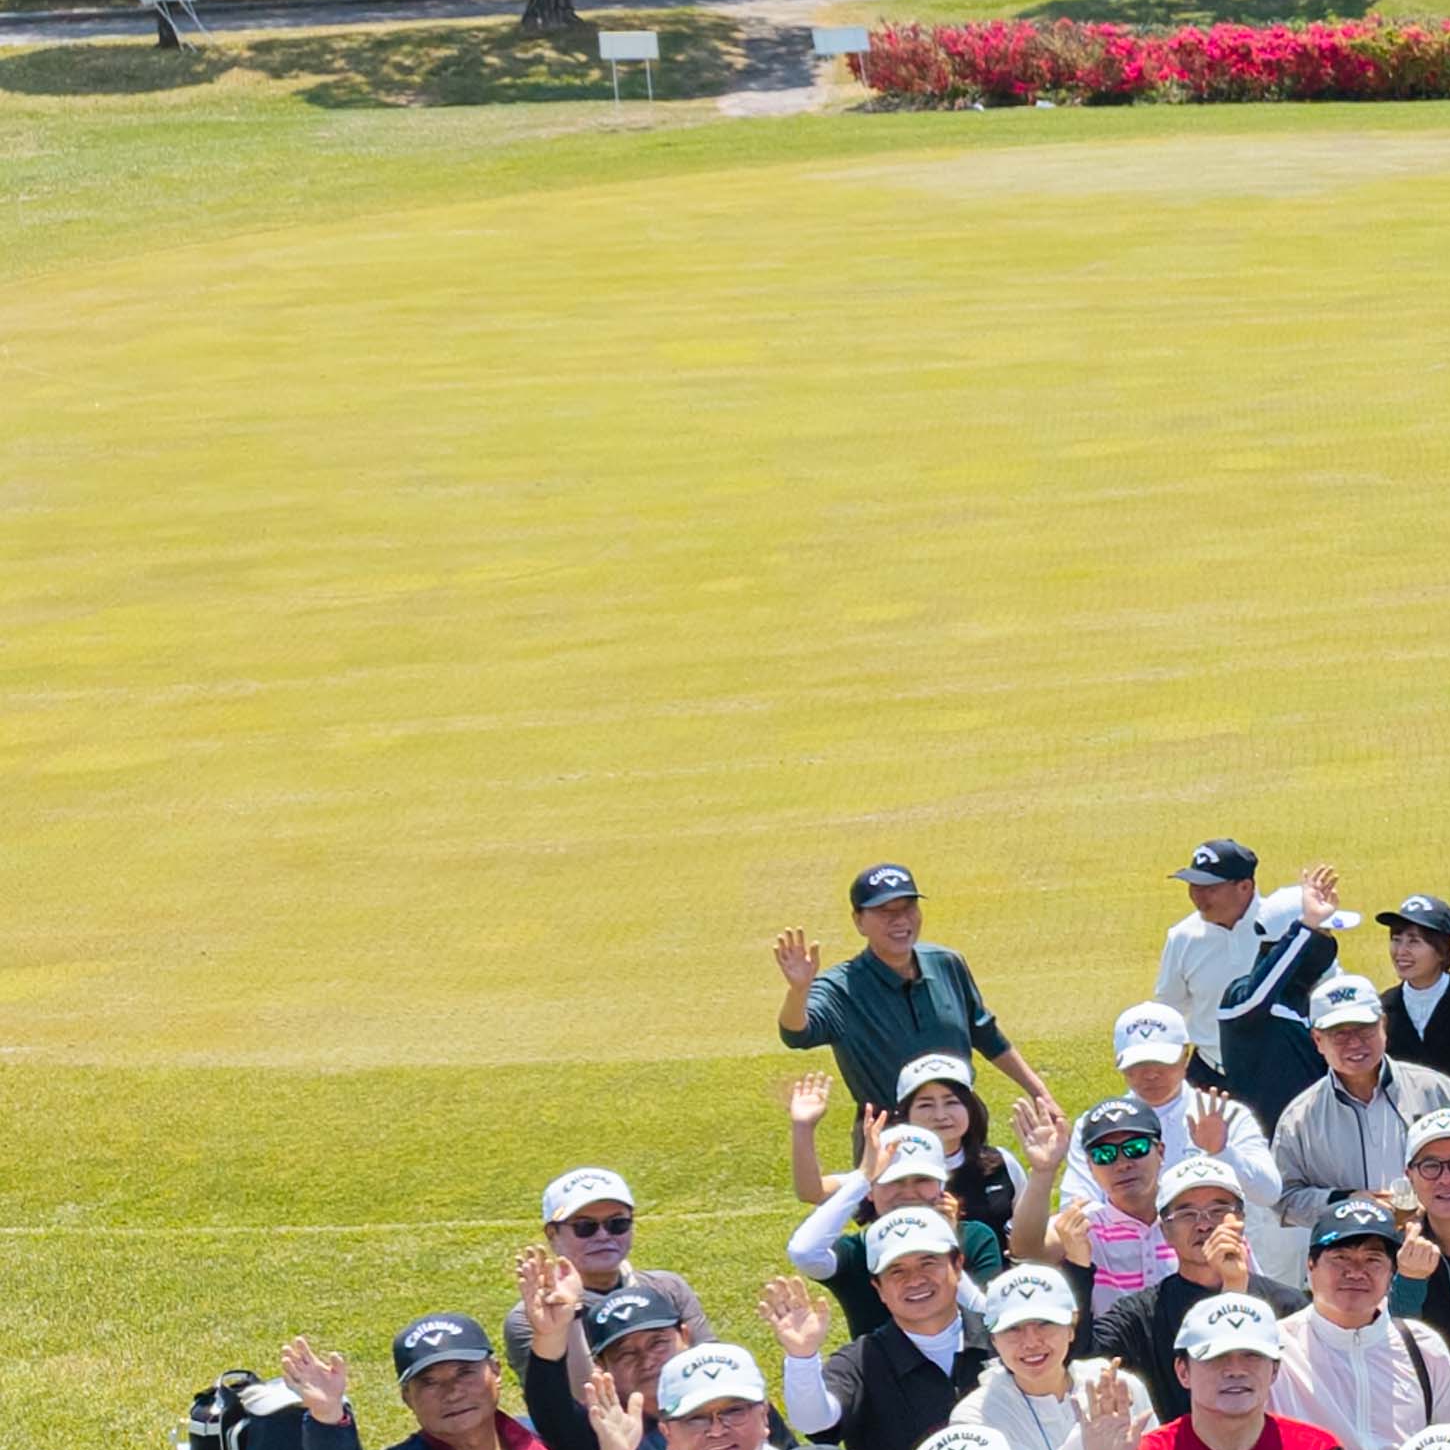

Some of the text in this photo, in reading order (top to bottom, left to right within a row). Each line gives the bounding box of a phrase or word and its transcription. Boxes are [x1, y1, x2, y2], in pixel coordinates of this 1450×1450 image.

[1091, 1102, 1138, 1122] Callaway
[564, 1175, 611, 1193] Callaway
[880, 1215, 926, 1238] Callaway
[1001, 1277, 1052, 1297] Callaway
[597, 1296, 648, 1324] Callaway
[1209, 1303, 1261, 1324] Callaway
[406, 1322, 463, 1348] Callaway
[683, 1356, 739, 1378] Callaway
